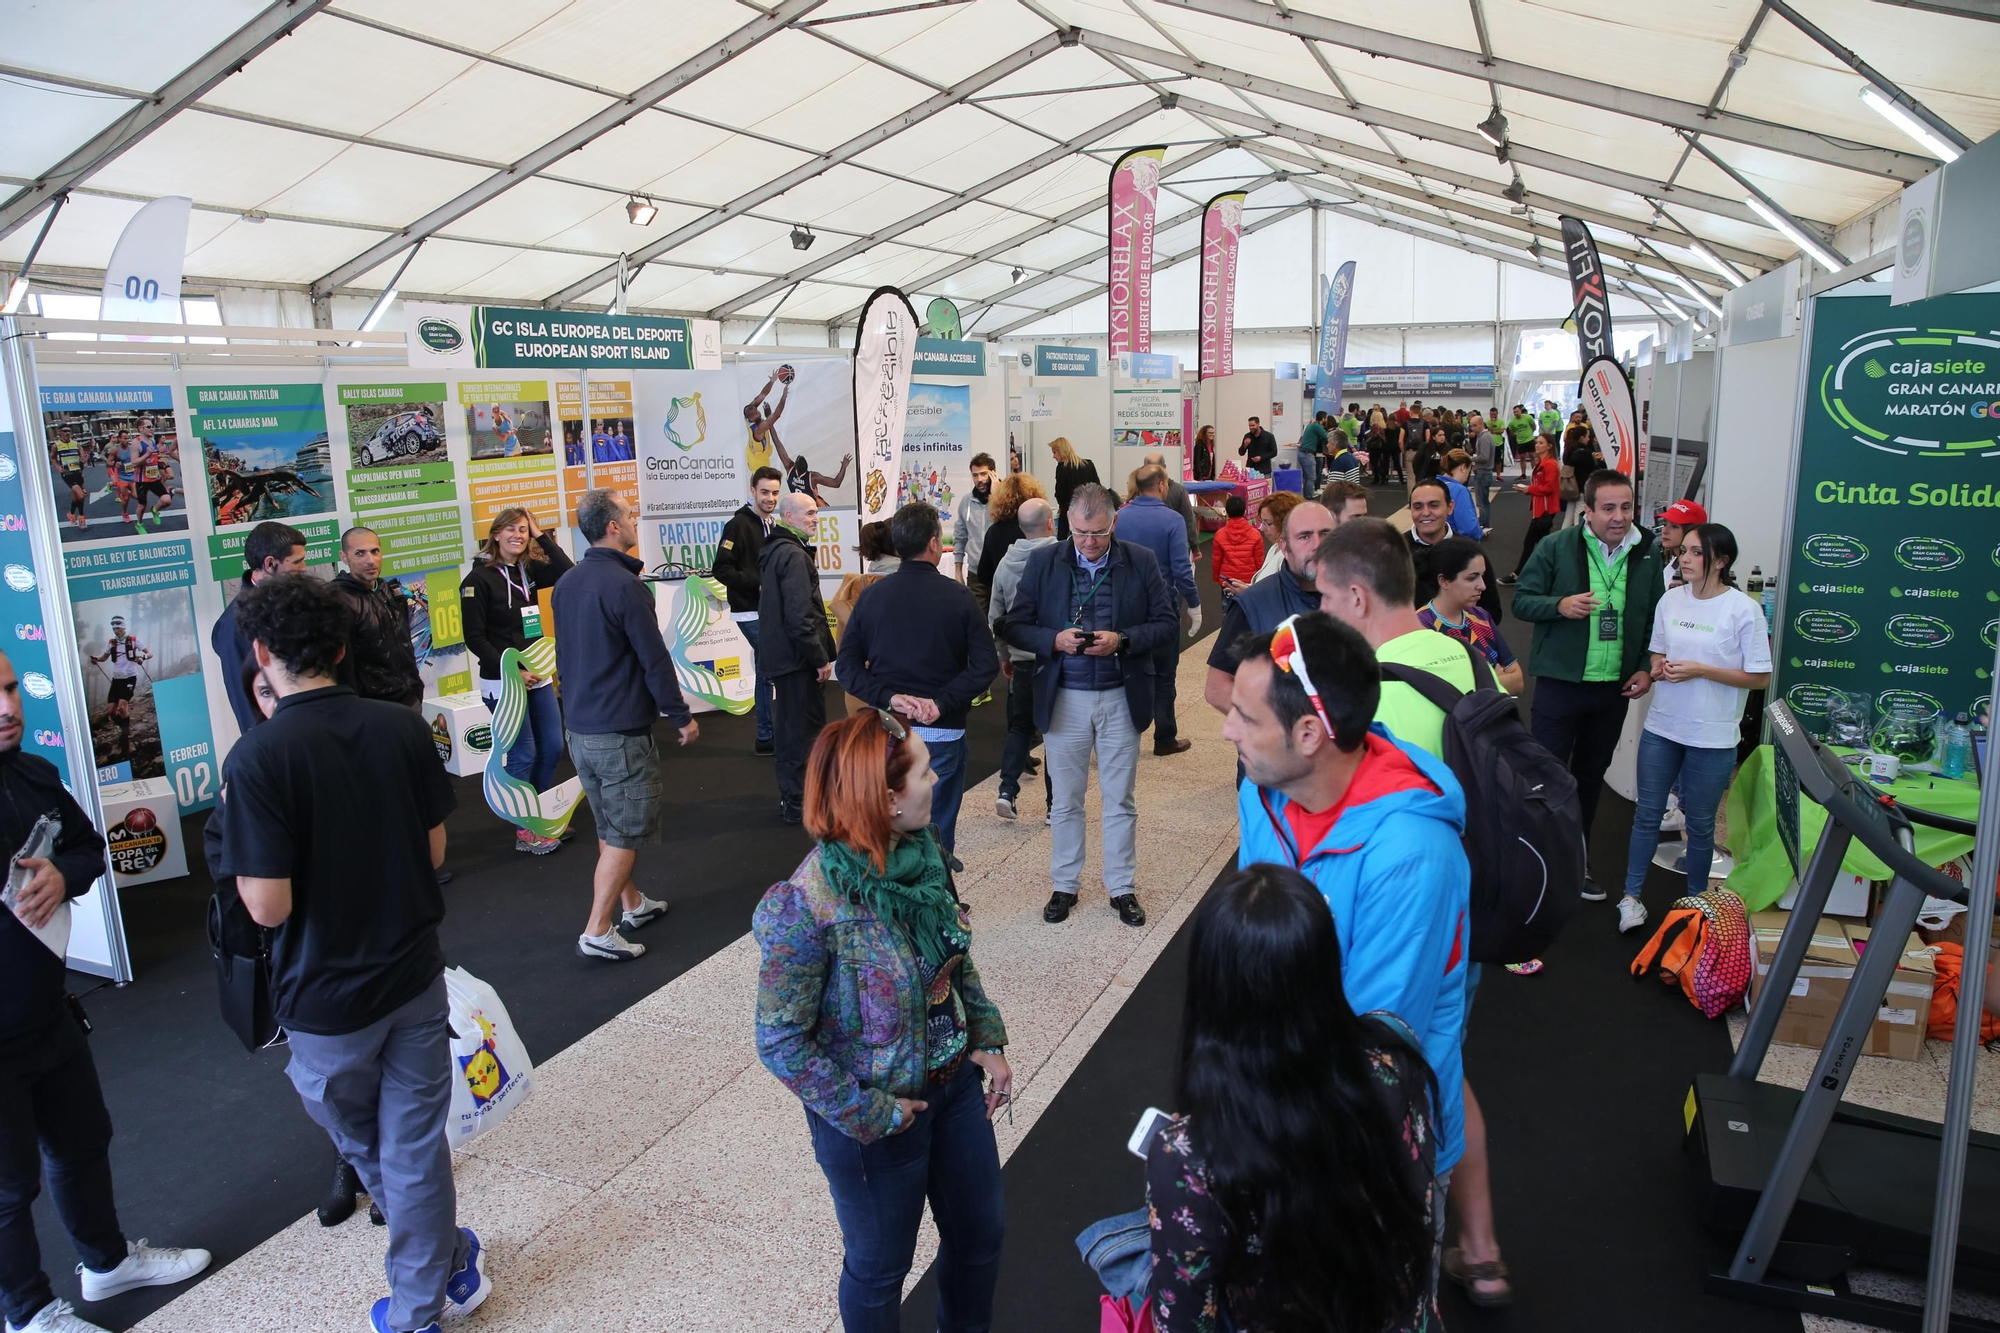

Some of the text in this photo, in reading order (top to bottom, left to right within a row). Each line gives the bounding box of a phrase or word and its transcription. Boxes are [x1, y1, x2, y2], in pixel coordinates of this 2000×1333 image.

[1228, 245, 1237, 278] DOLOR
[1139, 212, 1154, 343] FUERTE QUE EL DOLOR
[1227, 280, 1234, 293] EL
[1202, 235, 1227, 375] PHYSIORELAX
[1226, 295, 1234, 316] QUE
[492, 321, 684, 342] GC ISLA EUROPEA DEL DEPORTE
[1224, 318, 1233, 348] FUERTE
[515, 343, 670, 360] EUROPEAN SPORT ISLAND
[1320, 325, 1331, 367] Beyond
[1324, 317, 1340, 376] Coast
[922, 353, 976, 364] CANARIA ACCESIBLE
[1045, 351, 1090, 362] PATRONATO DE TURISMO
[1051, 363, 1085, 372] DE GRAN CANARIA
[1889, 359, 1986, 377] cajasiete
[199, 388, 279, 402] GRAN CANARIA TRIATLÓN
[343, 388, 403, 399] RALLY ISLAS CANARIAS
[1888, 383, 1933, 395] GRAN
[53, 390, 153, 404] GRAN CANARIA MARATÓN
[1117, 410, 1175, 418] REDES SOCIALES!
[1885, 400, 1966, 416] MARATÓN
[203, 417, 278, 430] AFL 14 CANARIAS MMA
[390, 418, 418, 443] TIGER
[923, 441, 963, 452] infinitas
[351, 469, 421, 484] MASPALOMAS OPEN WATER
[646, 471, 736, 482] Isla Europea del Deporte
[475, 484, 502, 496] CHAMPIONS
[502, 483, 510, 492] CUP
[511, 482, 519, 491] THE
[1815, 481, 1901, 505] Cinta
[354, 490, 419, 506] TRANSGRANCANARIA BIKE
[488, 504, 501, 514] GRAN
[222, 537, 240, 549] GRAN
[70, 544, 186, 569] COPA DEL REY DE BALONCESTO
[323, 547, 332, 558] GC
[422, 554, 439, 566] WAVES
[440, 551, 462, 563] FESTIVAL
[662, 546, 674, 572] Y
[101, 568, 189, 591] TRANSGRANCANARIA HG
[436, 587, 455, 603] JUNIO
[1812, 583, 1865, 594] cajasiete
[1904, 587, 1959, 599] cajasiete
[434, 604, 460, 641] 06
[15, 623, 46, 641] GCM
[709, 635, 738, 646] Sport Island
[1804, 658, 1856, 669] cajasiete
[1894, 663, 1949, 675] cajasiete
[446, 674, 463, 689] JULIO
[35, 729, 65, 747] GCM
[169, 742, 209, 764] FEBRERO
[175, 762, 214, 807] 02
[110, 846, 159, 861] COPA DEL
[120, 854, 158, 872] REY
[1831, 1036, 1854, 1075] DOMYOS
[461, 1113, 472, 1121] tu
